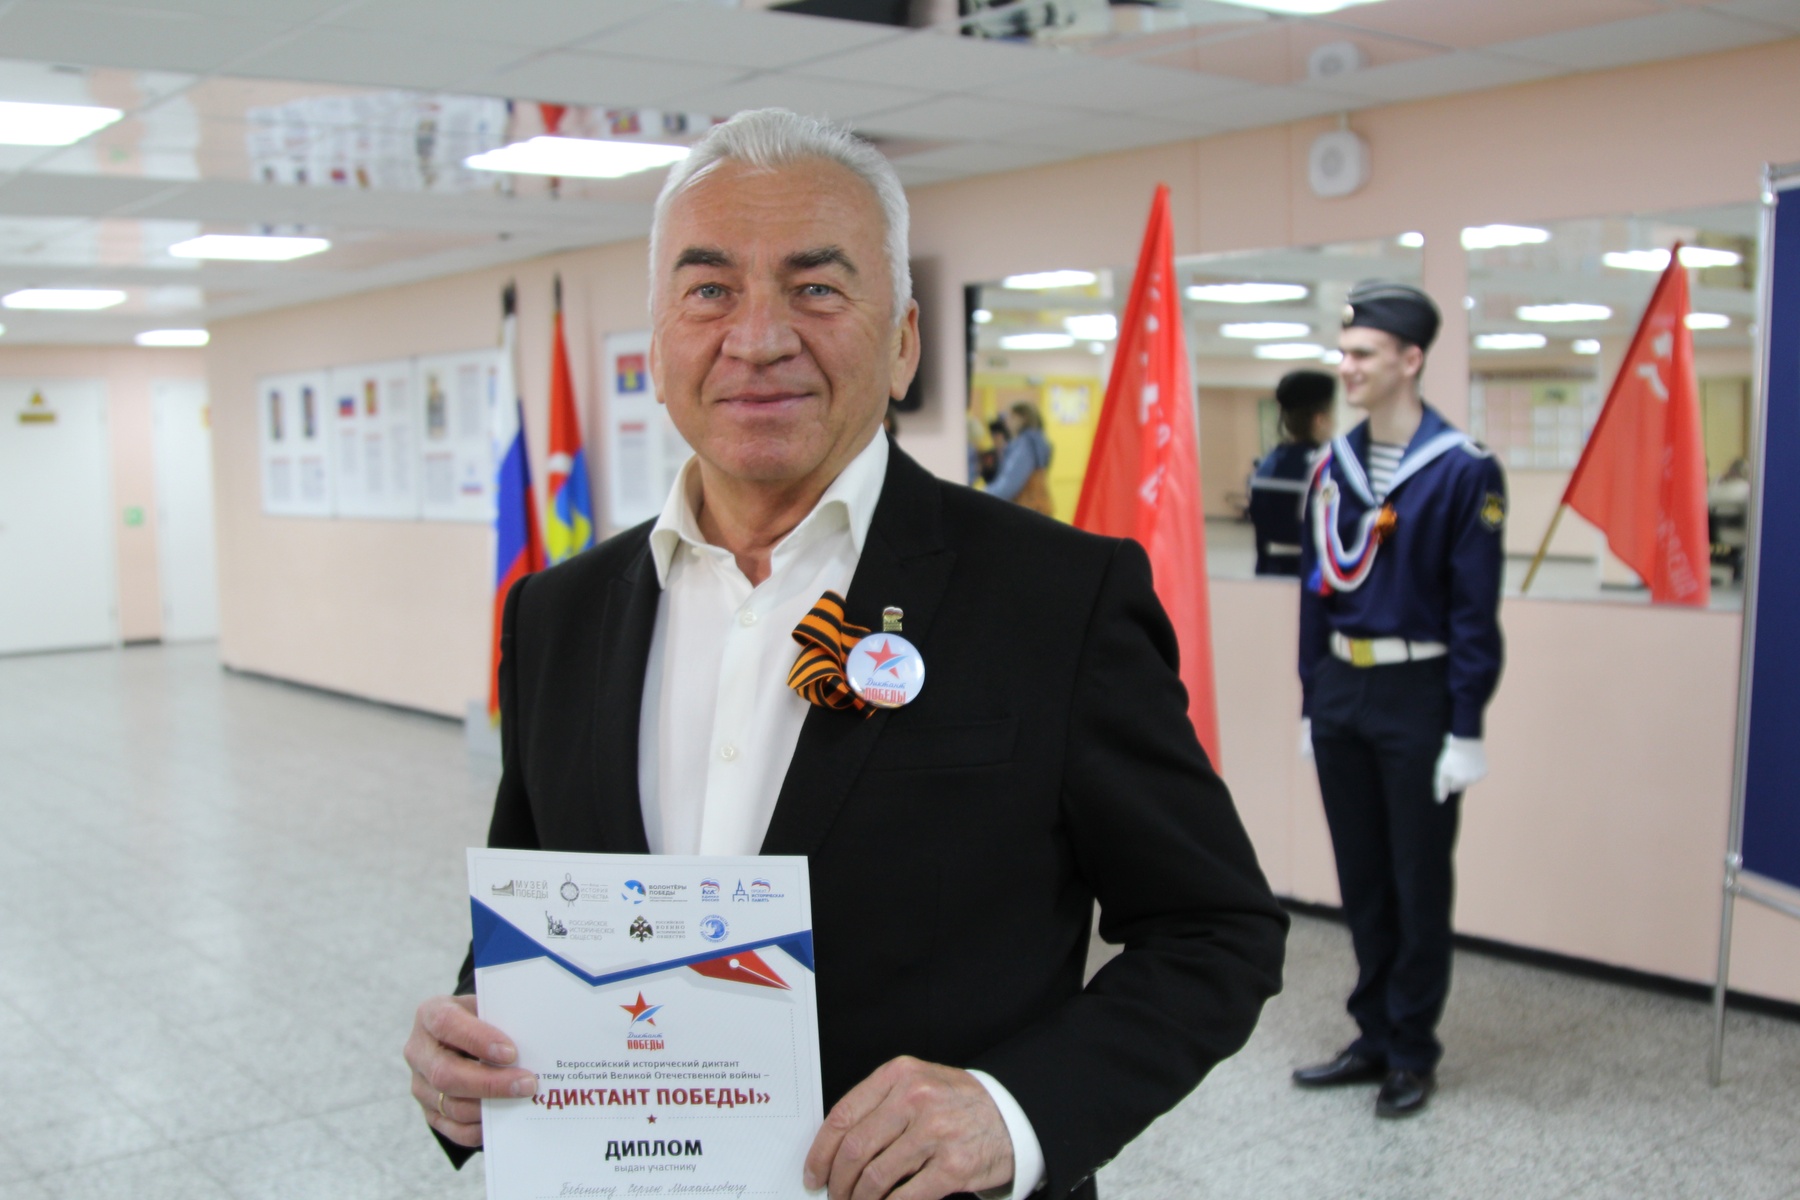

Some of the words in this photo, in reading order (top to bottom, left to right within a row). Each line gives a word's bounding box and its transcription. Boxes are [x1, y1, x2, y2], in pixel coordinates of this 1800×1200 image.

[865, 677, 906, 689] Диктант
[864, 688, 906, 703] ПОБЕДЫ
[515, 880, 548, 890] МУЗЕЙ
[515, 889, 549, 899] ПОБЕДЫ
[569, 927, 615, 935] ИСТОРИЧЕСКОЕ
[627, 1031, 663, 1039] Диктант
[627, 1040, 665, 1051] ПОБЕДЫ
[556, 1060, 630, 1069] Всероссийский
[632, 1060, 700, 1069] исторический
[702, 1060, 740, 1068] диктант
[543, 1073, 565, 1081] тему
[567, 1071, 608, 1080] событий
[610, 1071, 652, 1079] Великой
[654, 1070, 727, 1079] Отечественной
[729, 1070, 761, 1079] войны
[531, 1088, 650, 1110] «ДИКТАНТ
[656, 1087, 771, 1109] ПОБЕДЫ»
[605, 1139, 703, 1161] ДИПЛОМ
[614, 1164, 646, 1172] выдан
[648, 1163, 697, 1173] участнику
[668, 1180, 747, 1199] Михайловичу
